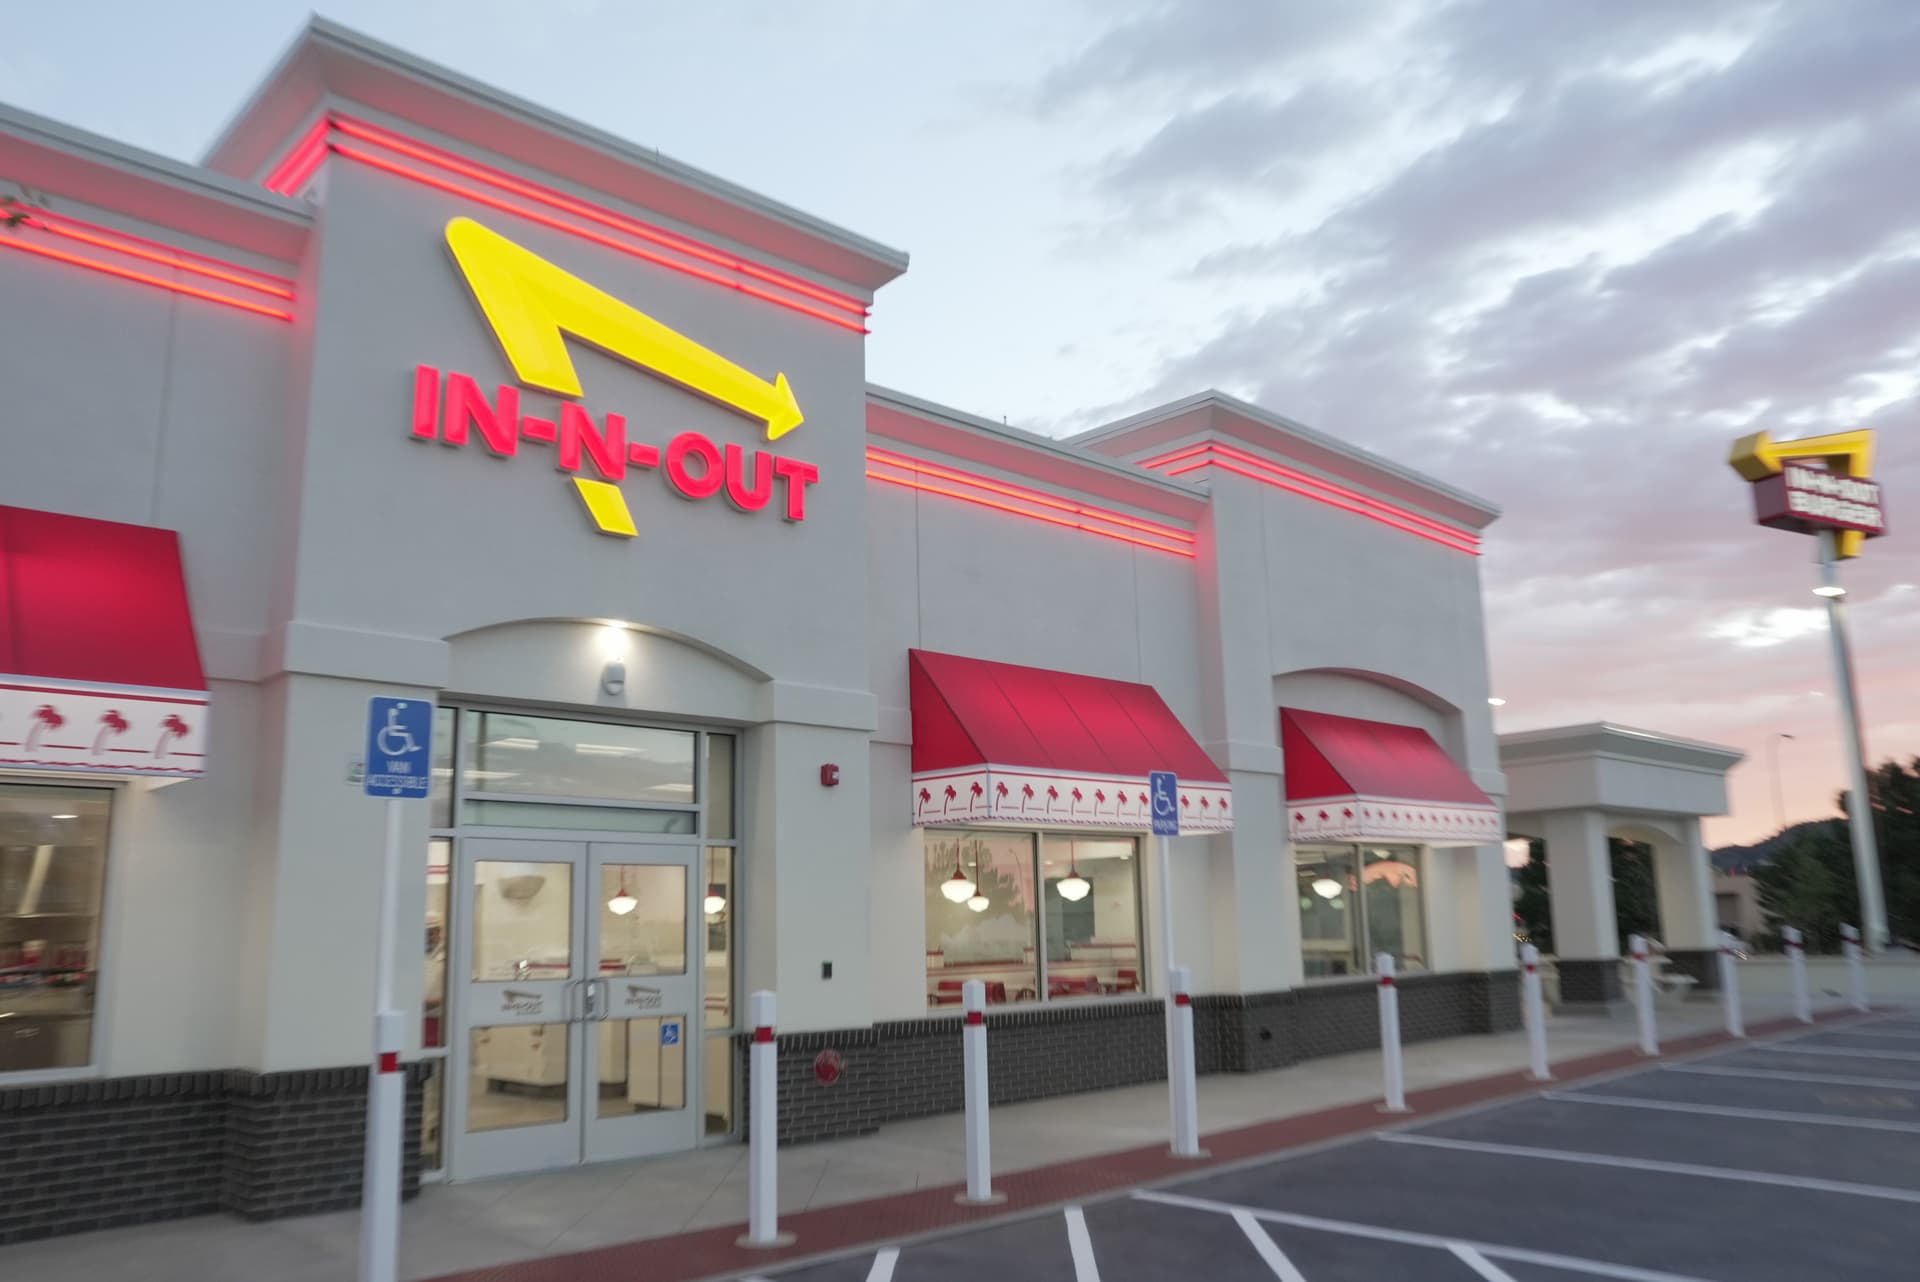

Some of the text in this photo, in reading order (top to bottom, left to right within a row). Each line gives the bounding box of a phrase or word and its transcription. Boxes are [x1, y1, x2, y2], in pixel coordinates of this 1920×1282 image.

[411, 363, 819, 522] IN-N-OUT
[386, 760, 412, 773] VAN
[366, 774, 429, 790] ACCESSIBLE
